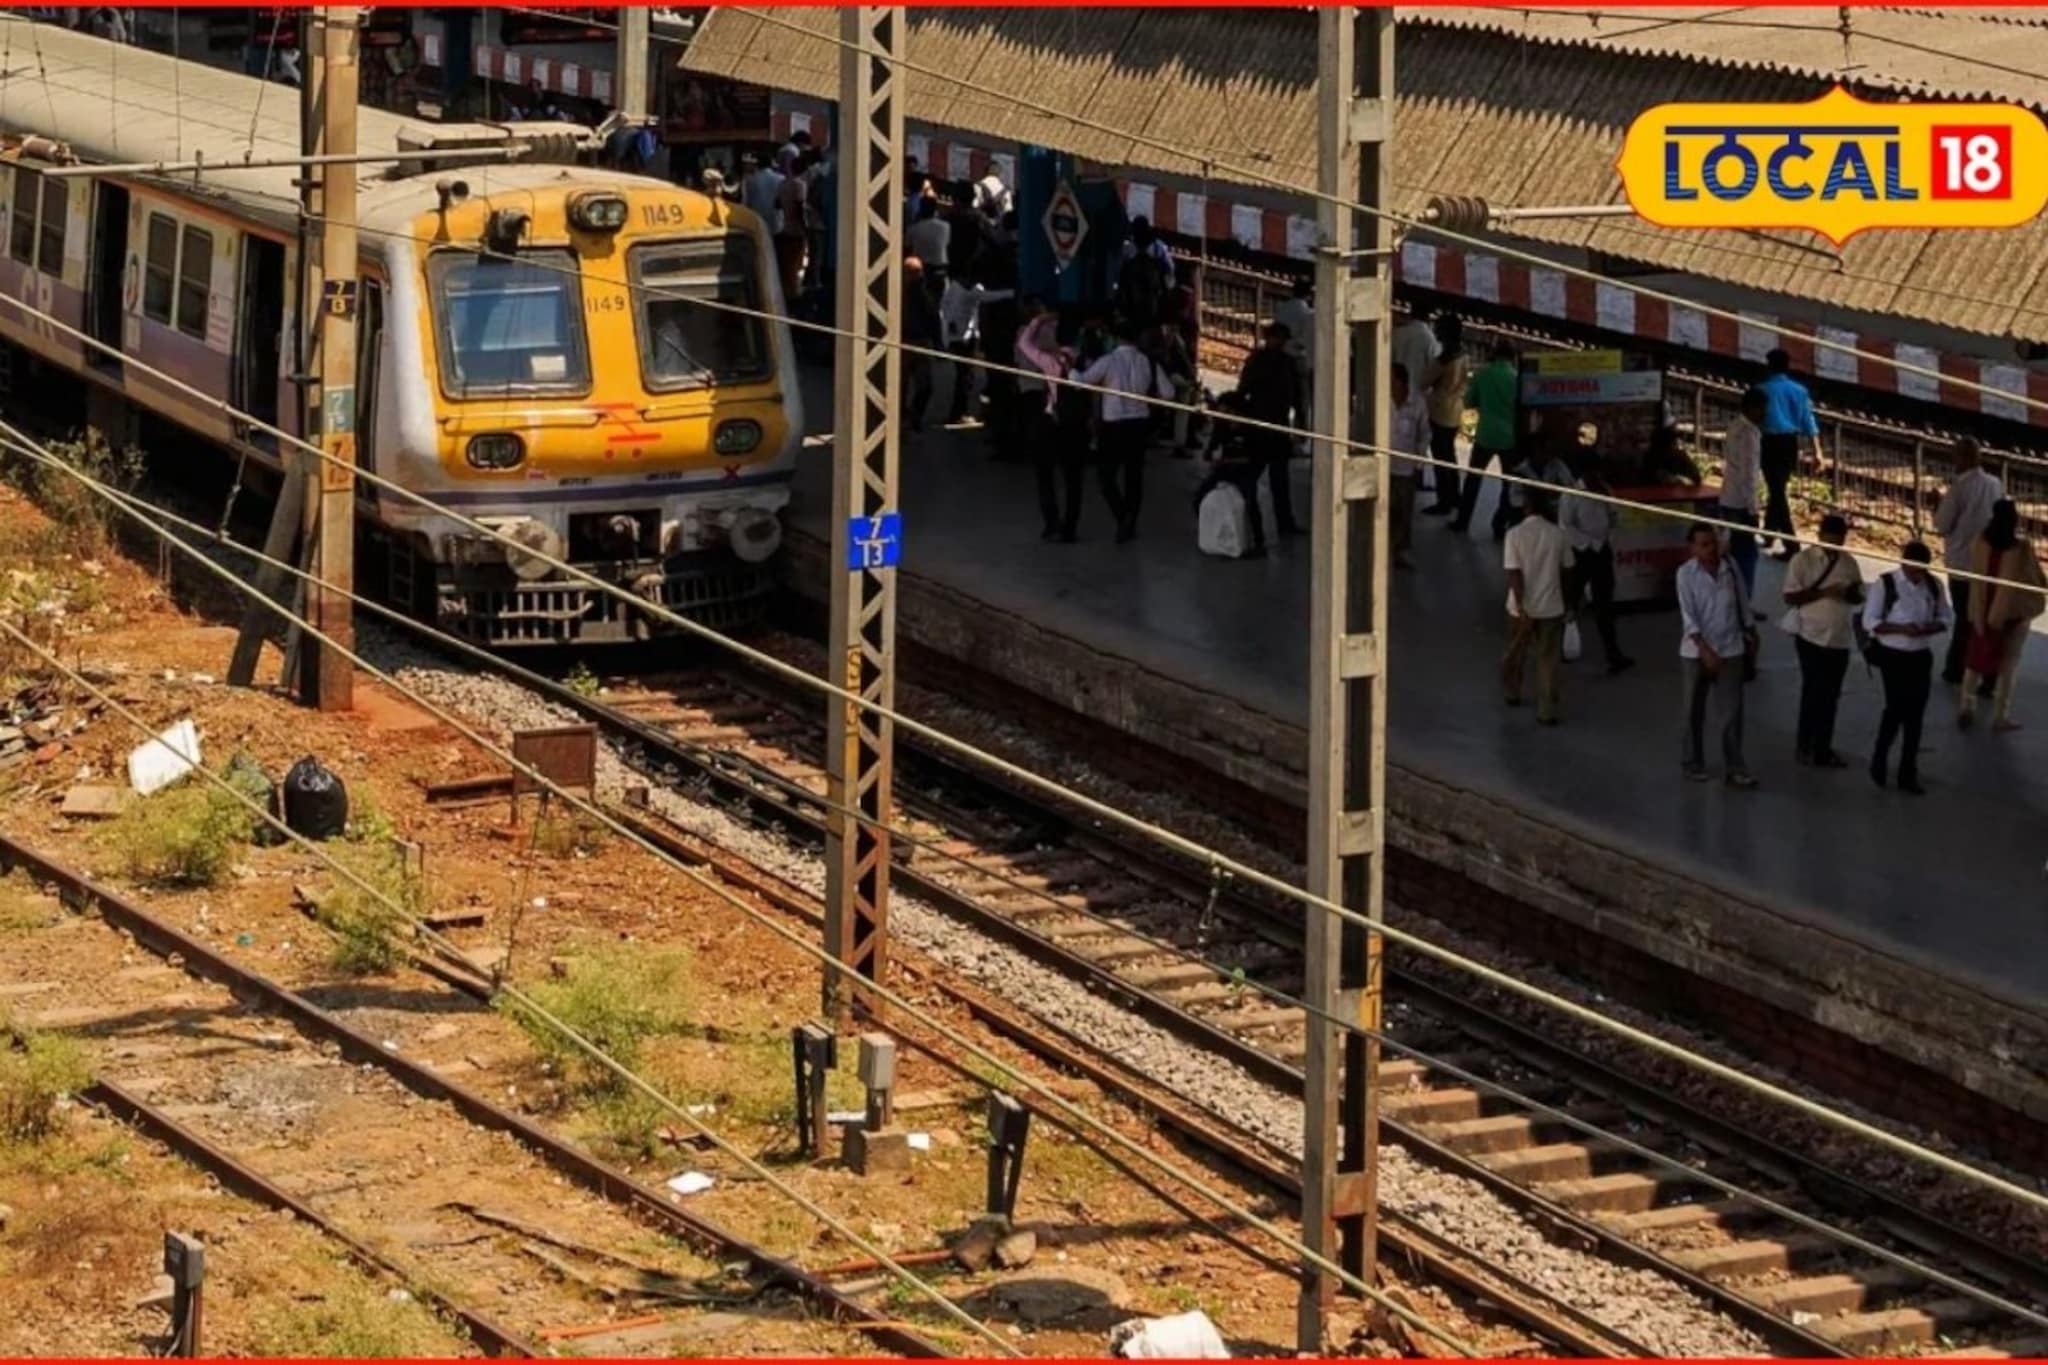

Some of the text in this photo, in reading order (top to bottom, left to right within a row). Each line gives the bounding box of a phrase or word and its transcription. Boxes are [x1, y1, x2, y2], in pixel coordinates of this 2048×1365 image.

[642, 204, 684, 226] 1149
[586, 295, 625, 313] 1149
[869, 517, 882, 539] 7
[863, 543, 883, 567] 13
